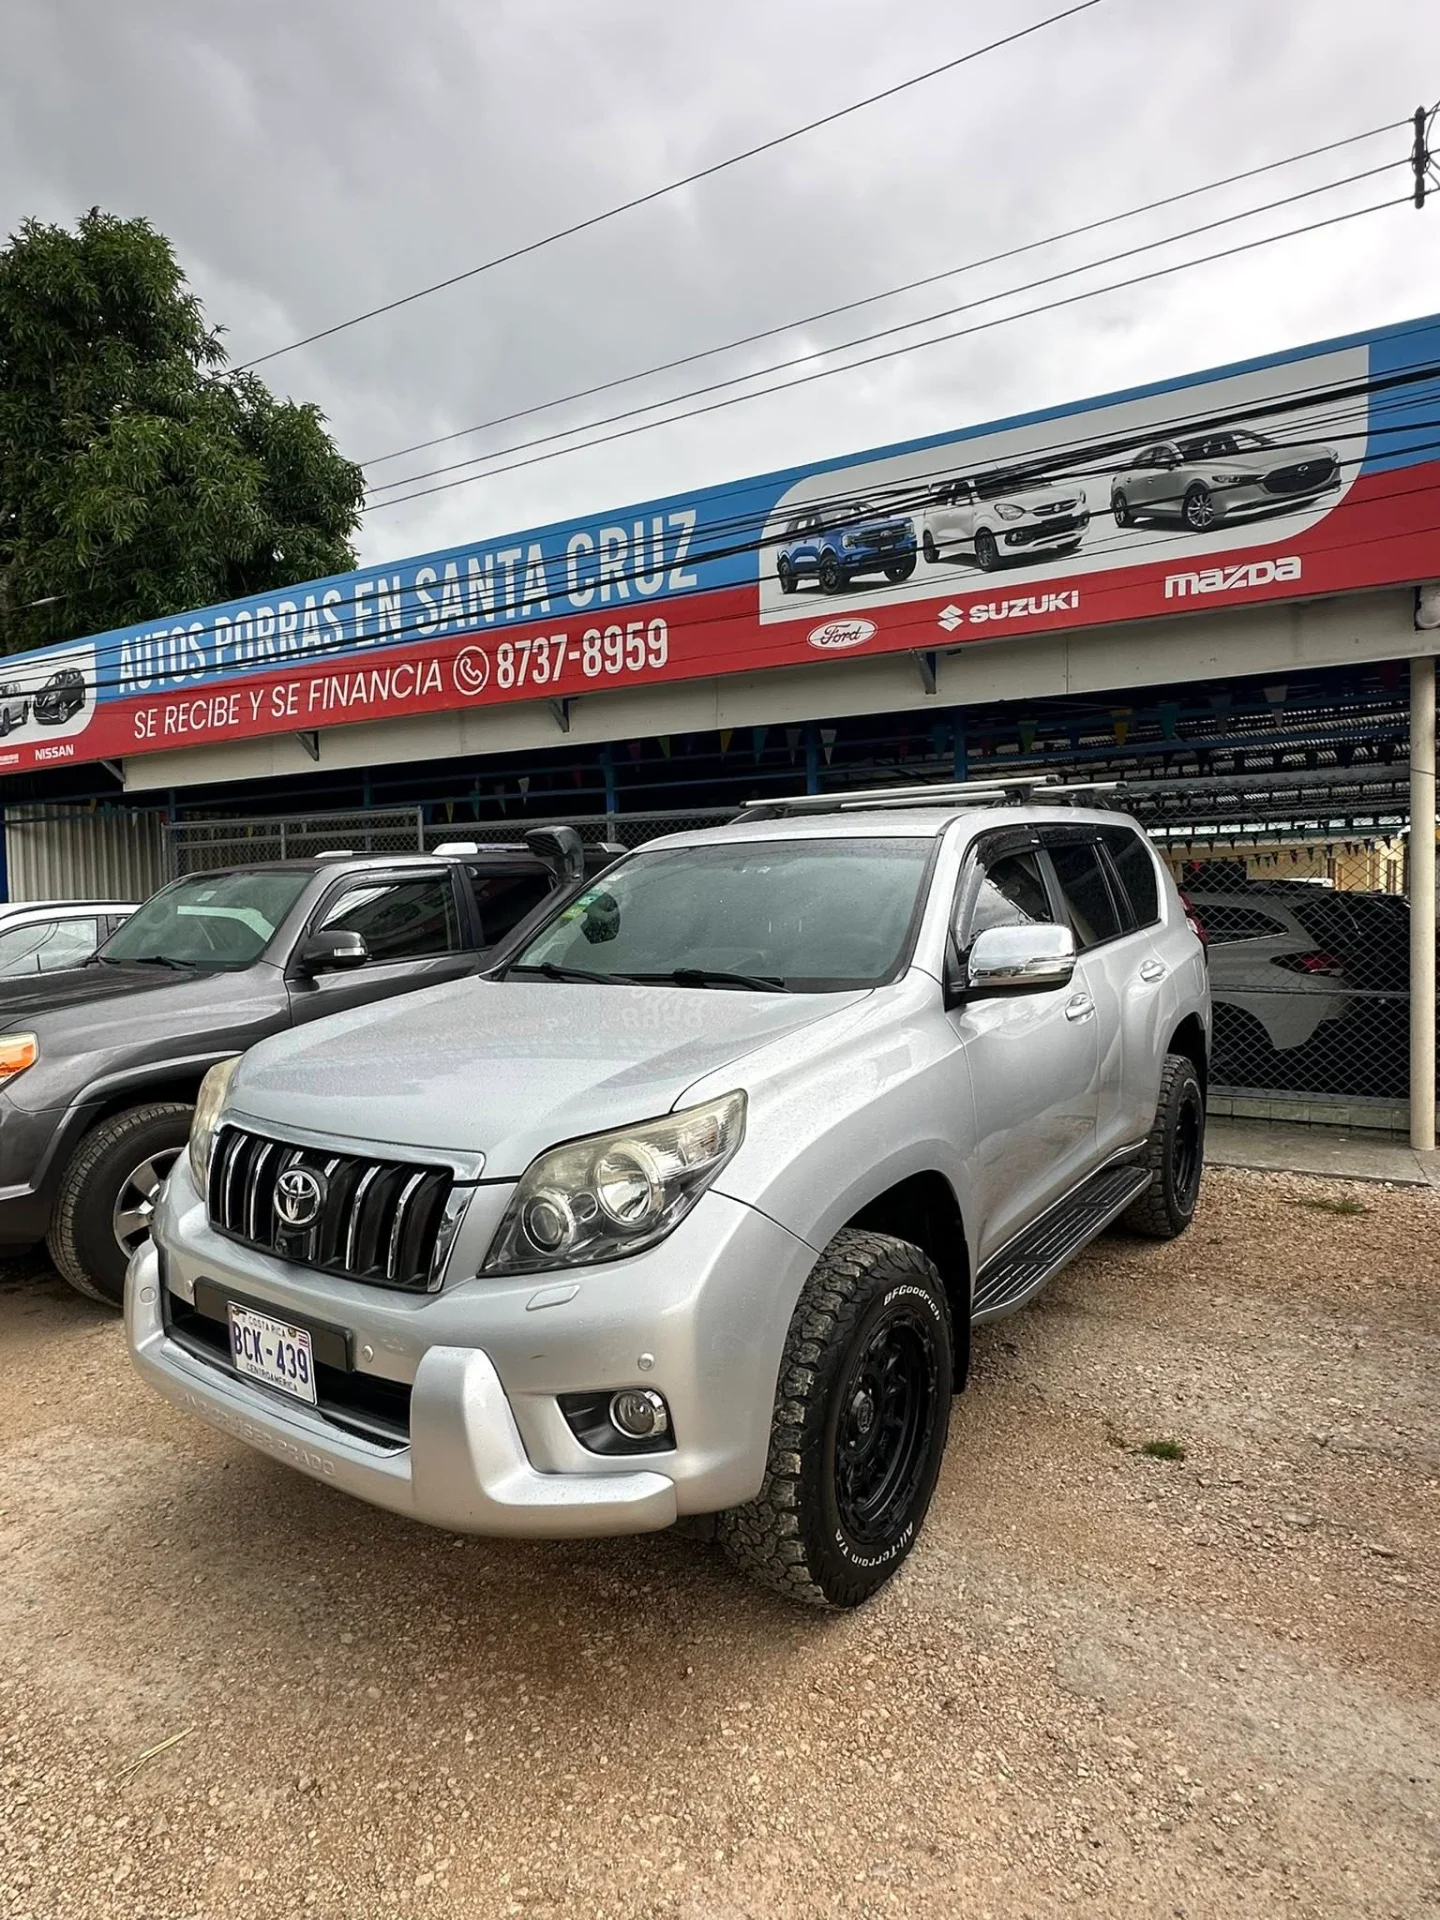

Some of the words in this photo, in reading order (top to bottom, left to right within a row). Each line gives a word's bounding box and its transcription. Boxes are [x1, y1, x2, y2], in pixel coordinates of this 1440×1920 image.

[119, 621, 205, 693] AUTOS
[214, 590, 343, 674] PORRAS
[354, 575, 402, 647] EN
[415, 543, 549, 635] SANTA
[566, 509, 697, 608] CRUZ
[968, 590, 1079, 623] SUZUKI
[820, 622, 862, 647] Ford
[134, 708, 158, 740] SE
[164, 693, 241, 735] RECIBE
[249, 689, 264, 721] Y
[271, 682, 300, 717] SE
[308, 659, 443, 712] FINANCIA
[497, 618, 668, 689] 8737-8959
[35, 744, 75, 761] NISSAN
[248, 1316, 270, 1331] COSTA
[232, 1320, 309, 1384] BCK-439
